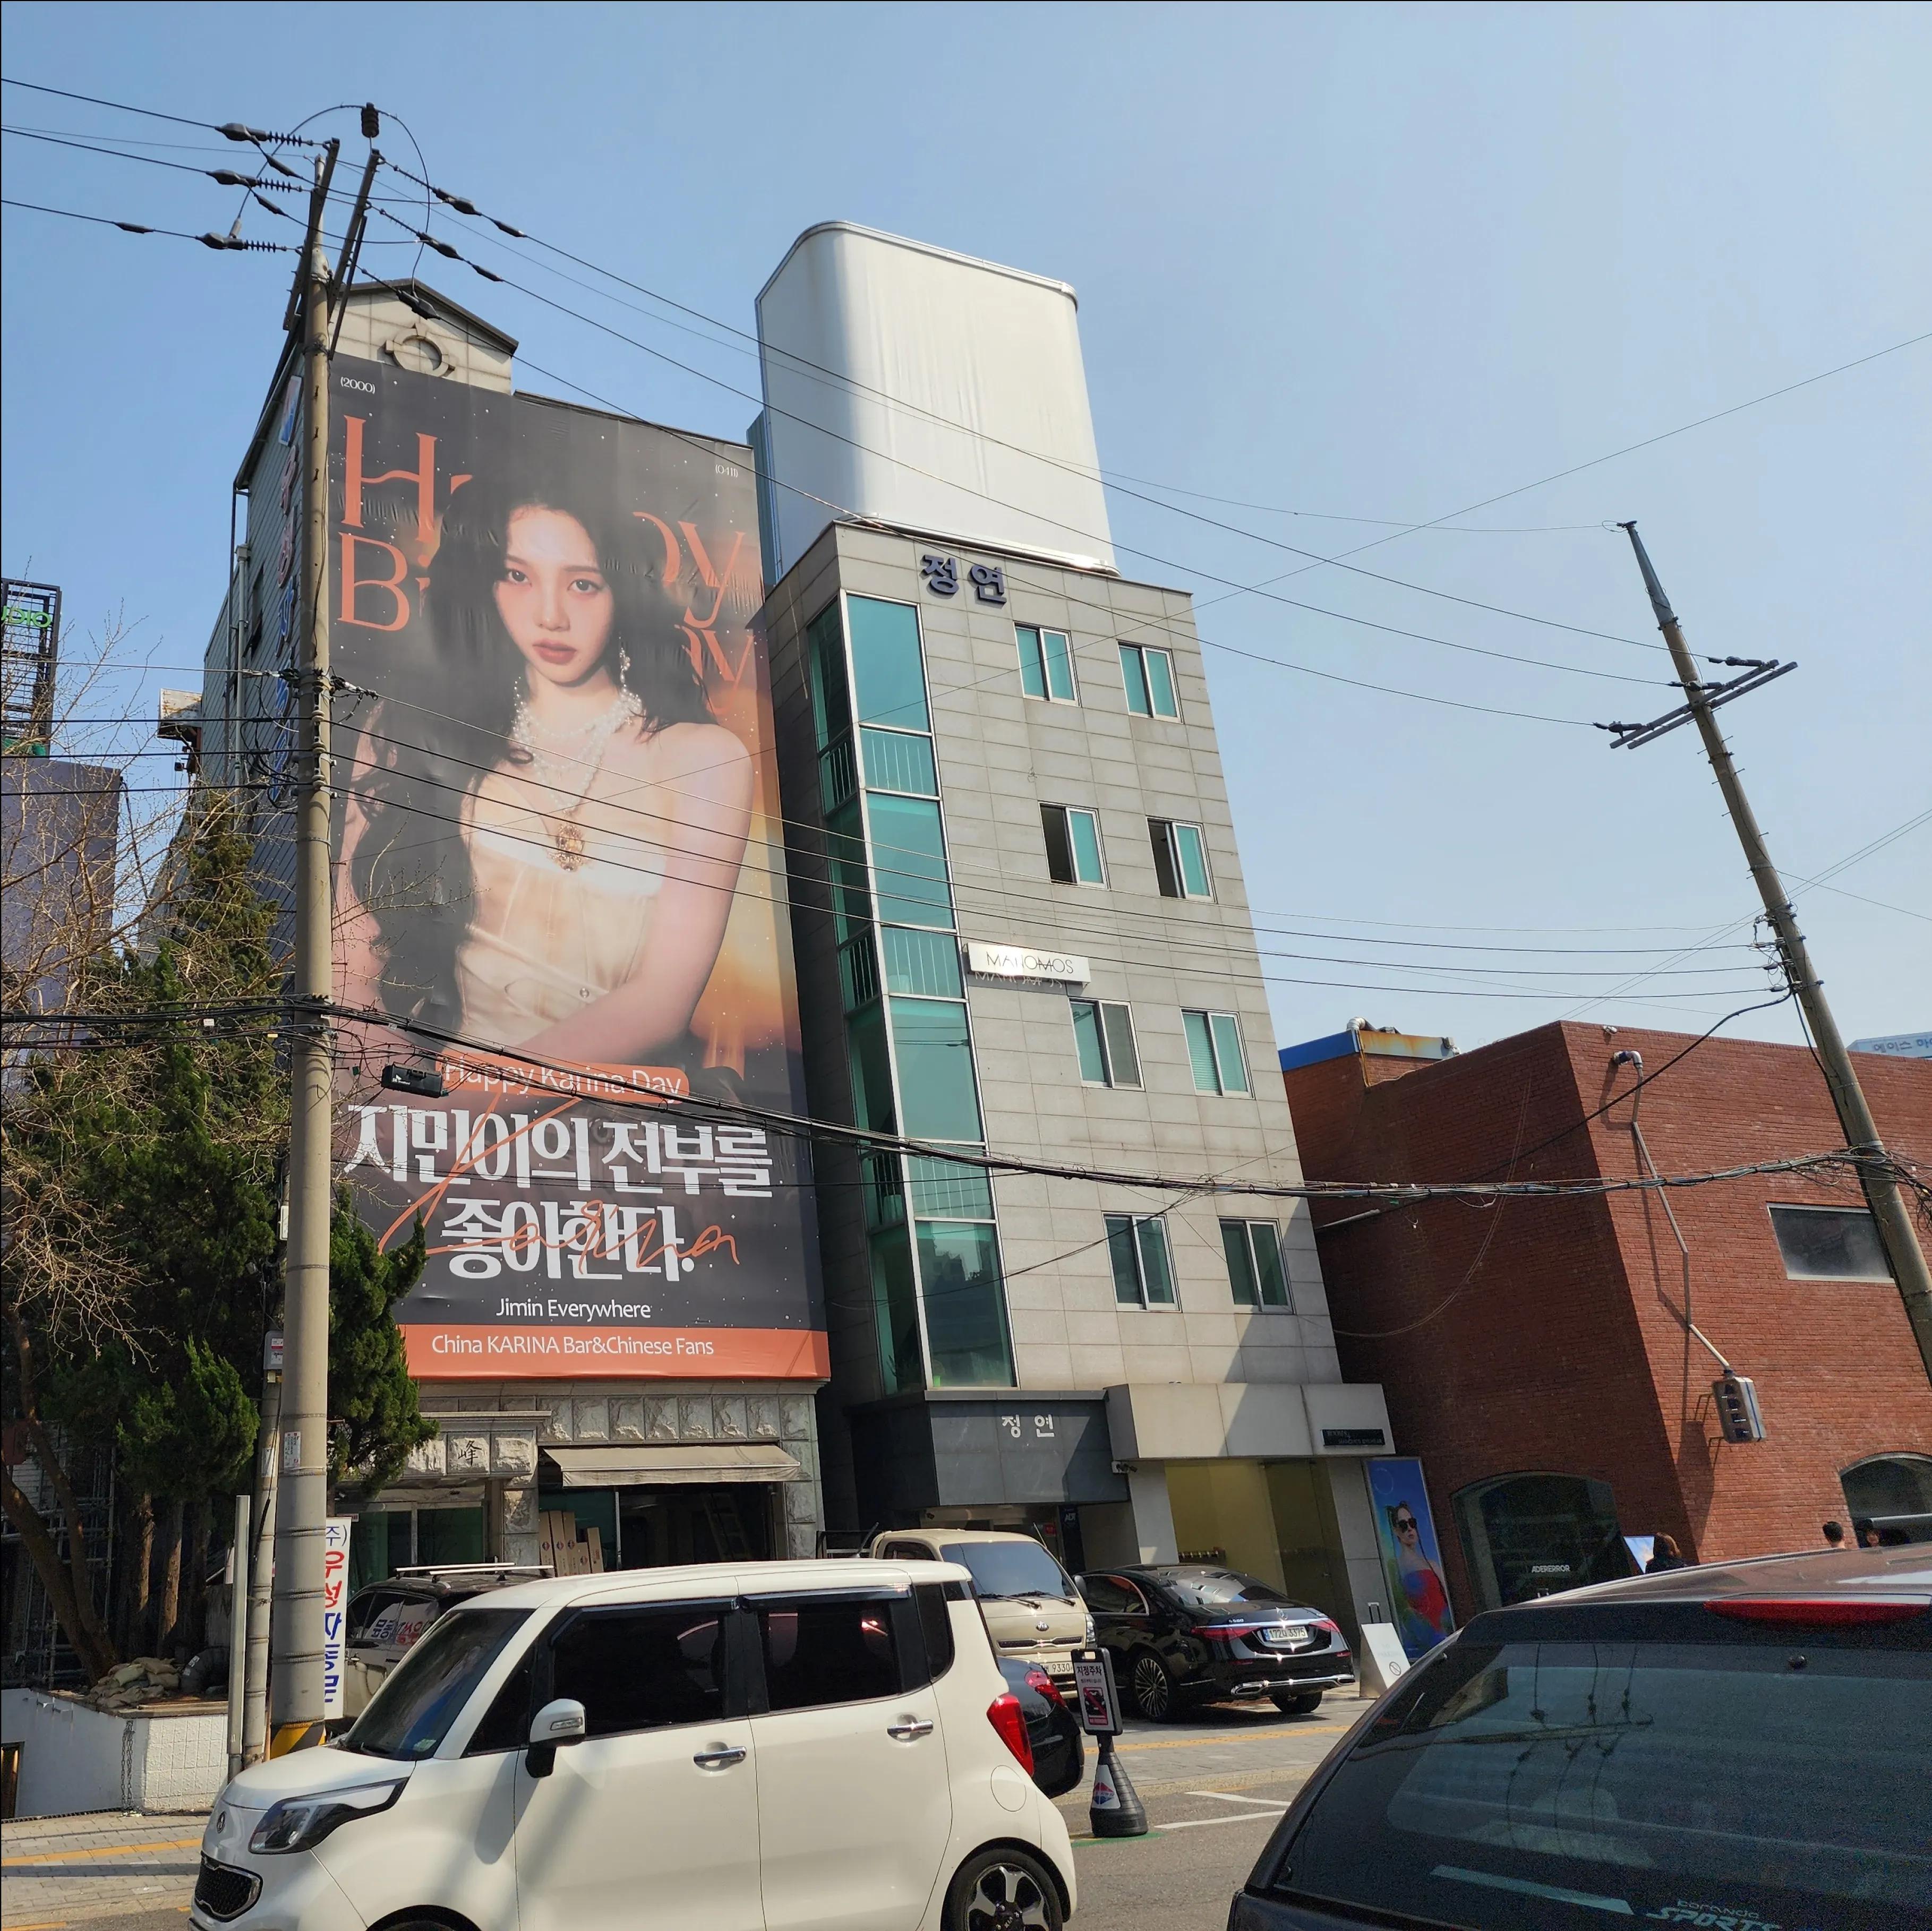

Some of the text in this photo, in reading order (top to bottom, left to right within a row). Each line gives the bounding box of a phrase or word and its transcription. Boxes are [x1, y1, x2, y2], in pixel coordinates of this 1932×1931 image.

[340, 376, 375, 394] (2000)
[715, 464, 738, 478] (0411)
[541, 1066, 626, 1093] Karina
[632, 1069, 681, 1103] Day
[344, 1104, 773, 1197] 지민이의 전부를
[496, 1298, 652, 1322] Jimin Everywhere
[432, 1334, 714, 1355] China KARINA Bar&Chinese Fans
[1052, 1663, 1070, 1672] 9330
[1077, 1665, 1102, 1677] 지정주차
